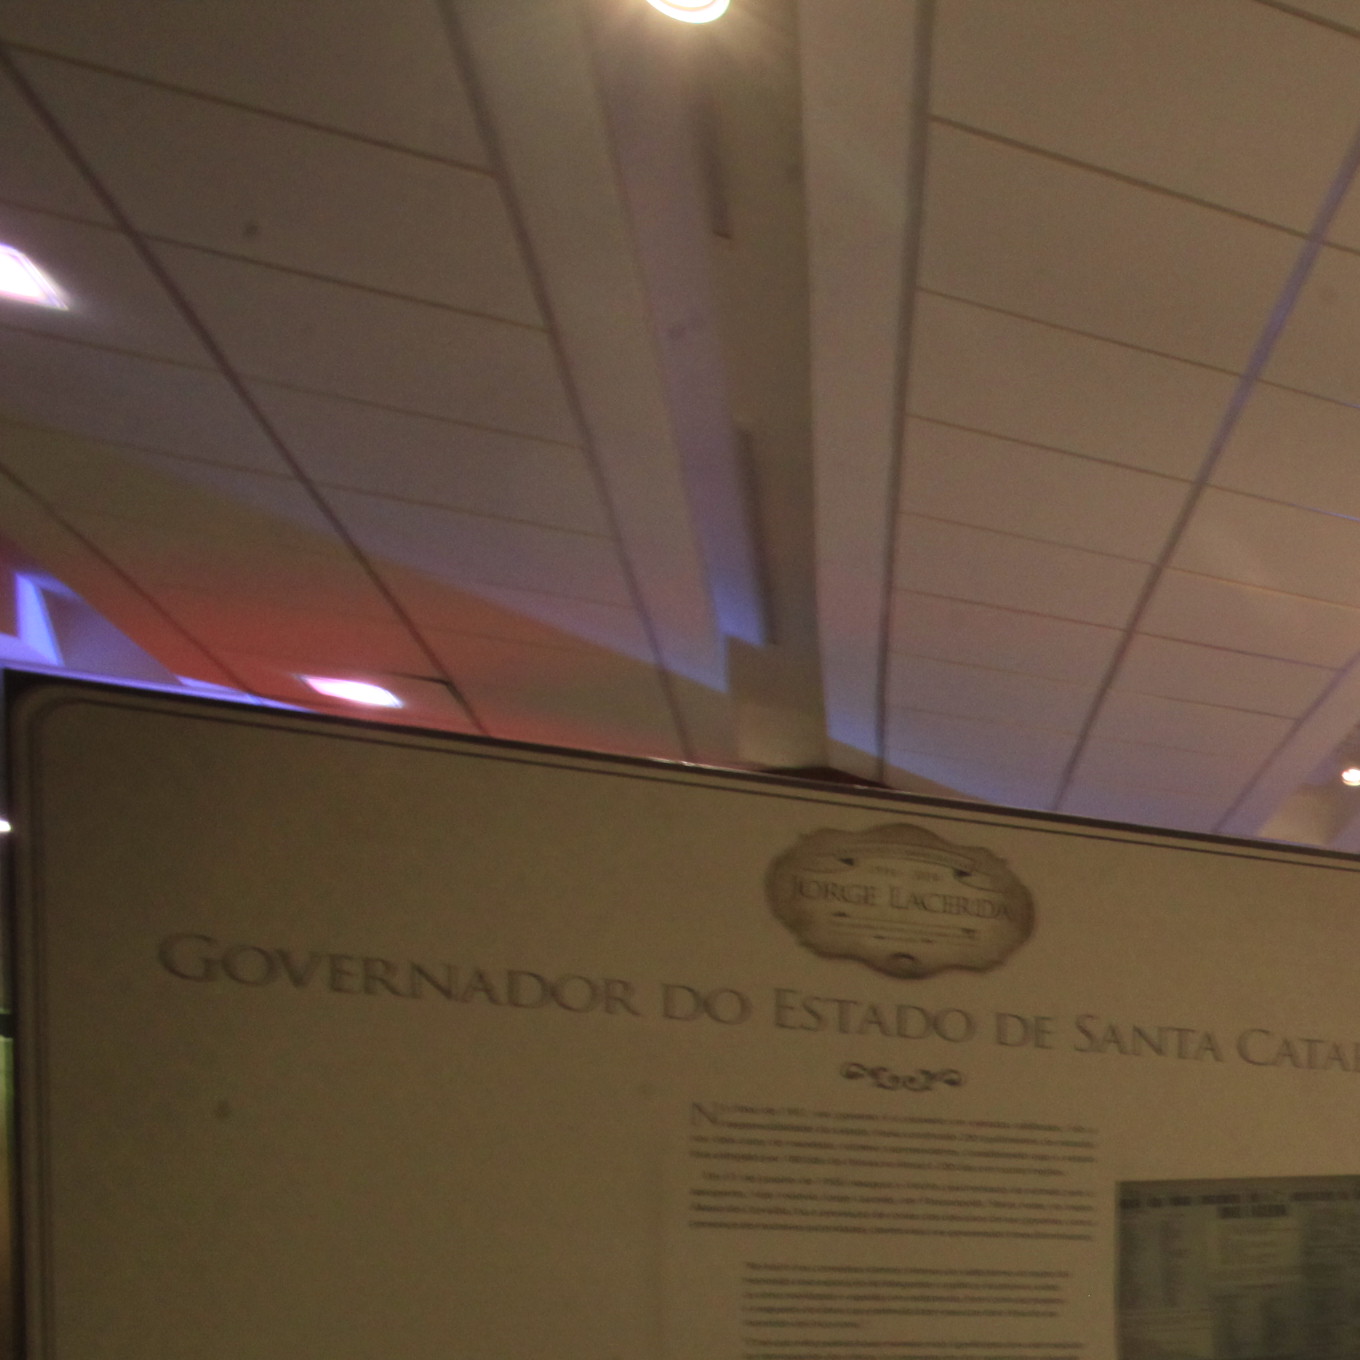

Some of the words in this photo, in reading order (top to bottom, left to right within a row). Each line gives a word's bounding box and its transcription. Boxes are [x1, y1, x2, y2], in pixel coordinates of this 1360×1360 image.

[790, 876, 879, 906] JORGE
[889, 884, 1014, 920] LACERDA
[159, 933, 639, 1017] GOVERNADOR
[661, 983, 750, 1026] DO
[774, 987, 975, 1044] ESTADO
[995, 1011, 1056, 1049] DE
[1073, 1013, 1224, 1063] SANTA
